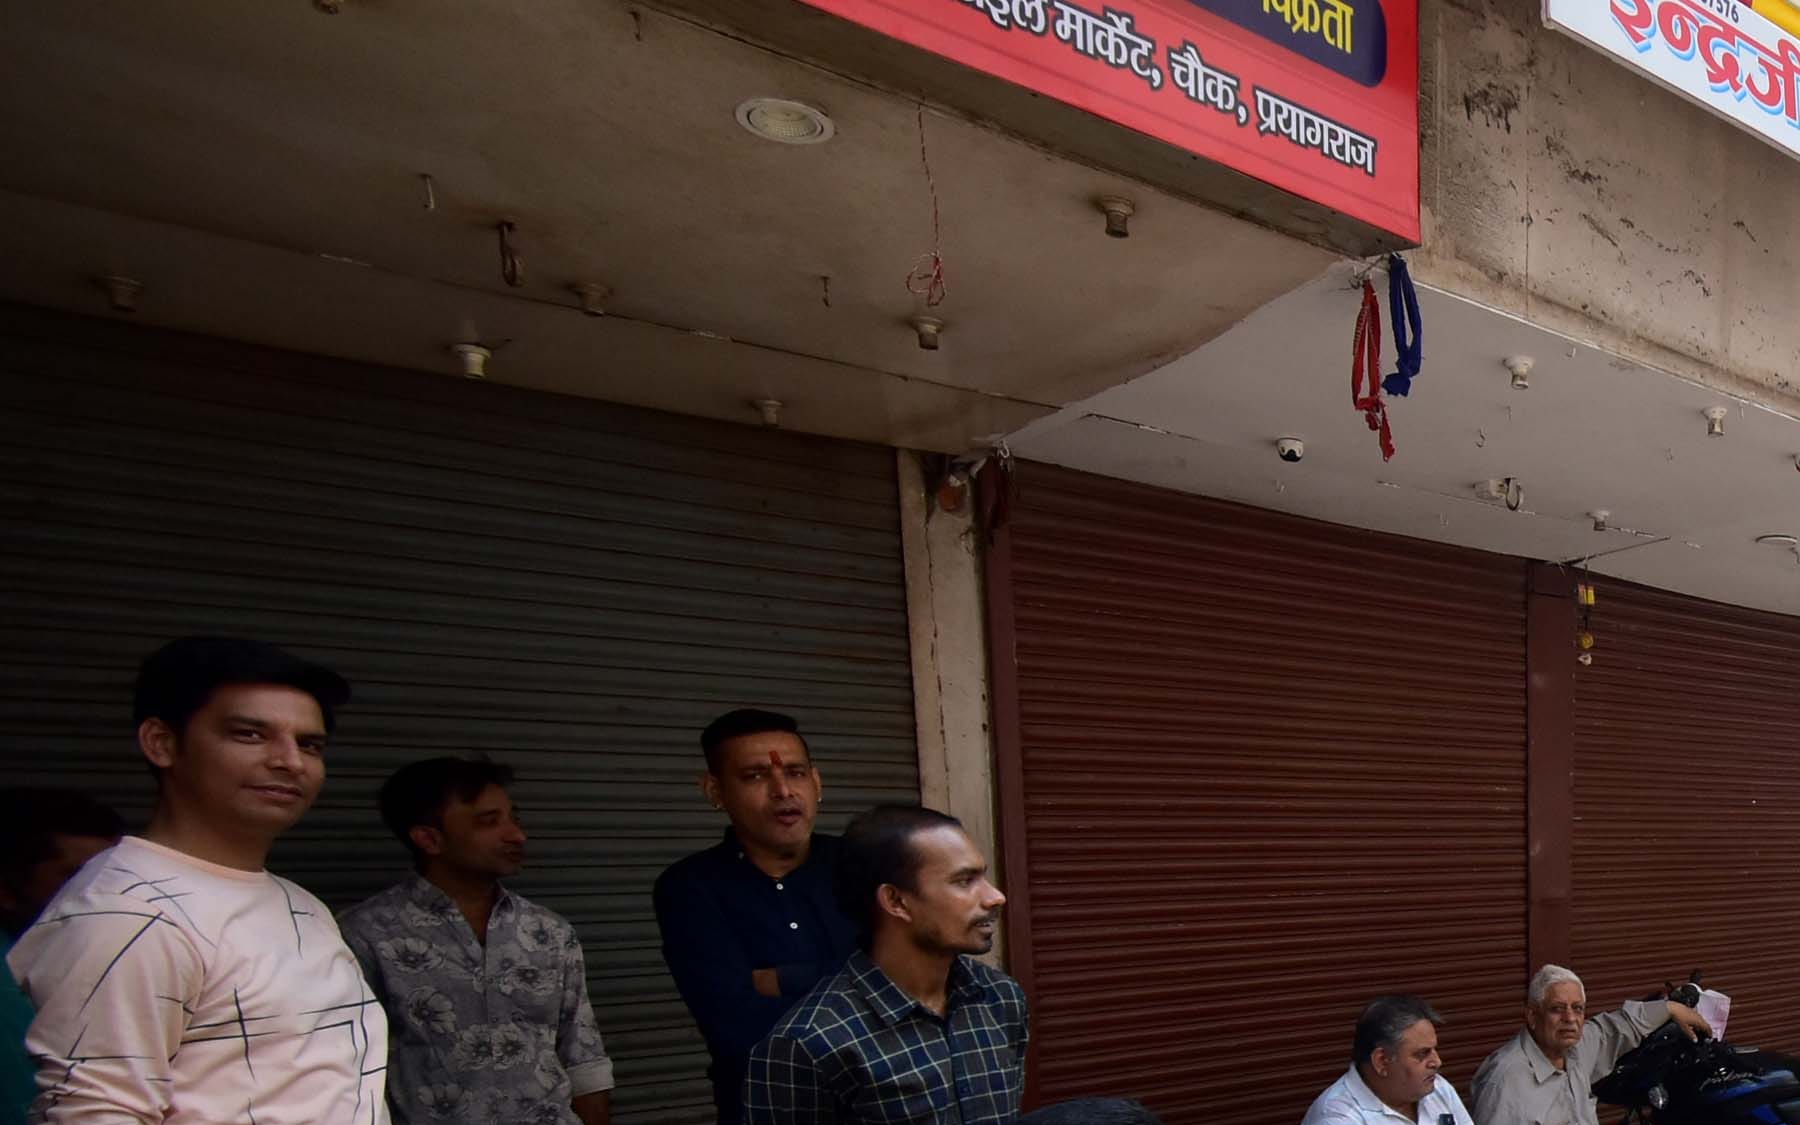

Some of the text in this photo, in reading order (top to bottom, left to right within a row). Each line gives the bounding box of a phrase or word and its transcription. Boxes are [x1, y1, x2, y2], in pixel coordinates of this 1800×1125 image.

[1054, 3, 1161, 87] मार्केट,
[1172, 46, 1247, 124] चौक,
[1255, 90, 1376, 173] प्रयागराज
